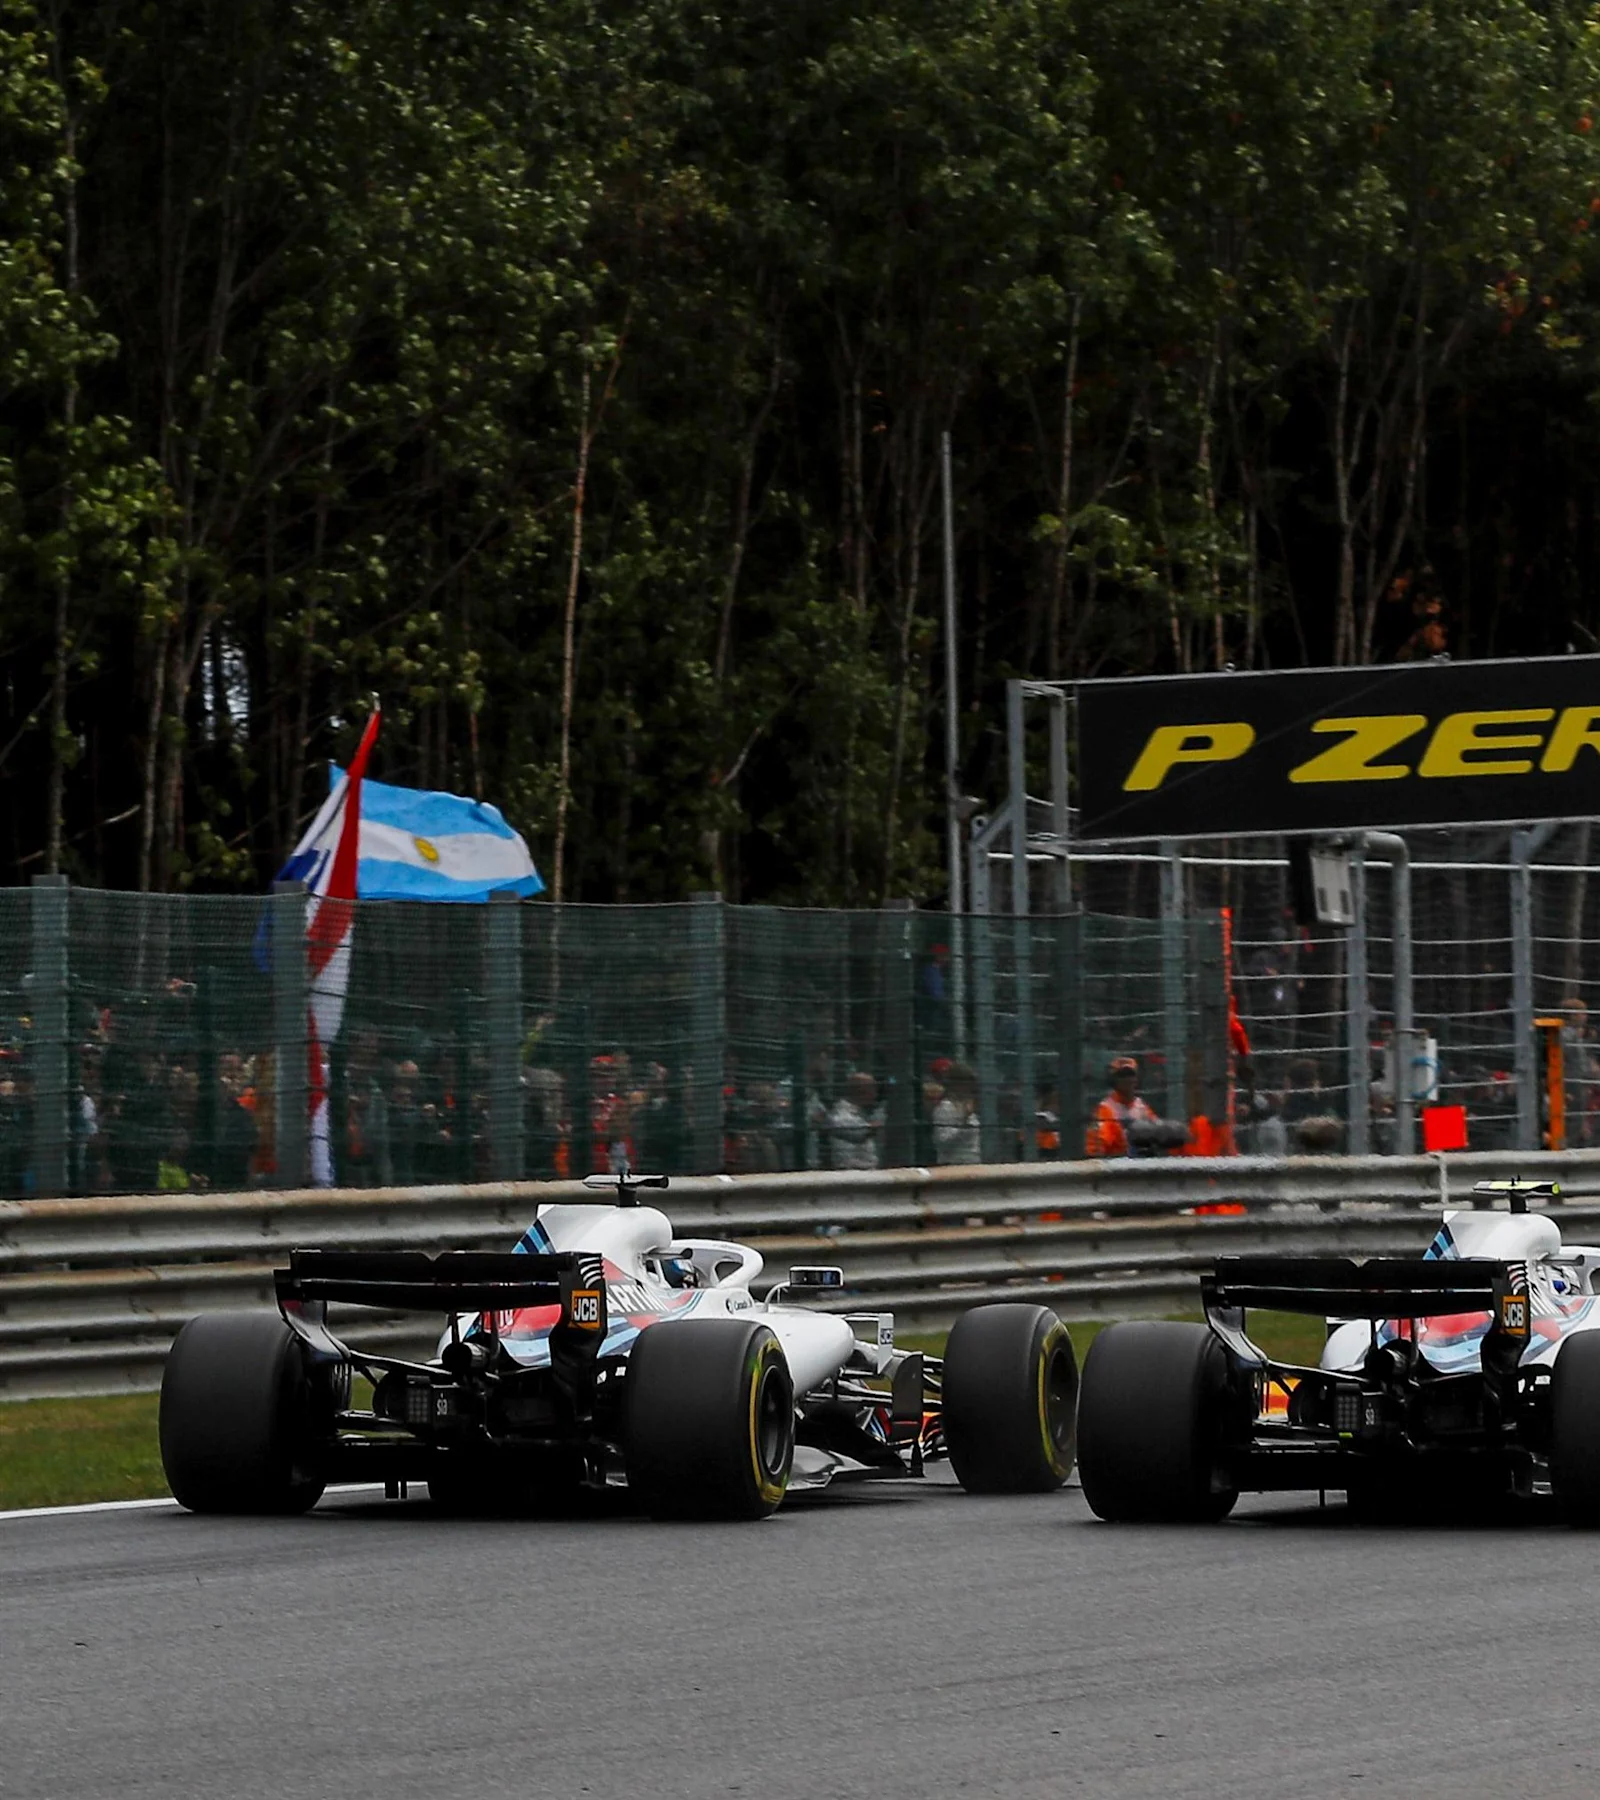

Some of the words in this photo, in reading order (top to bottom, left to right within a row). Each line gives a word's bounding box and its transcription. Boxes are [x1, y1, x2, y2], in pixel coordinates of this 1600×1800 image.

[1122, 722, 1256, 792] P
[574, 1297, 598, 1321] JCB
[1504, 1303, 1524, 1327] JCB
